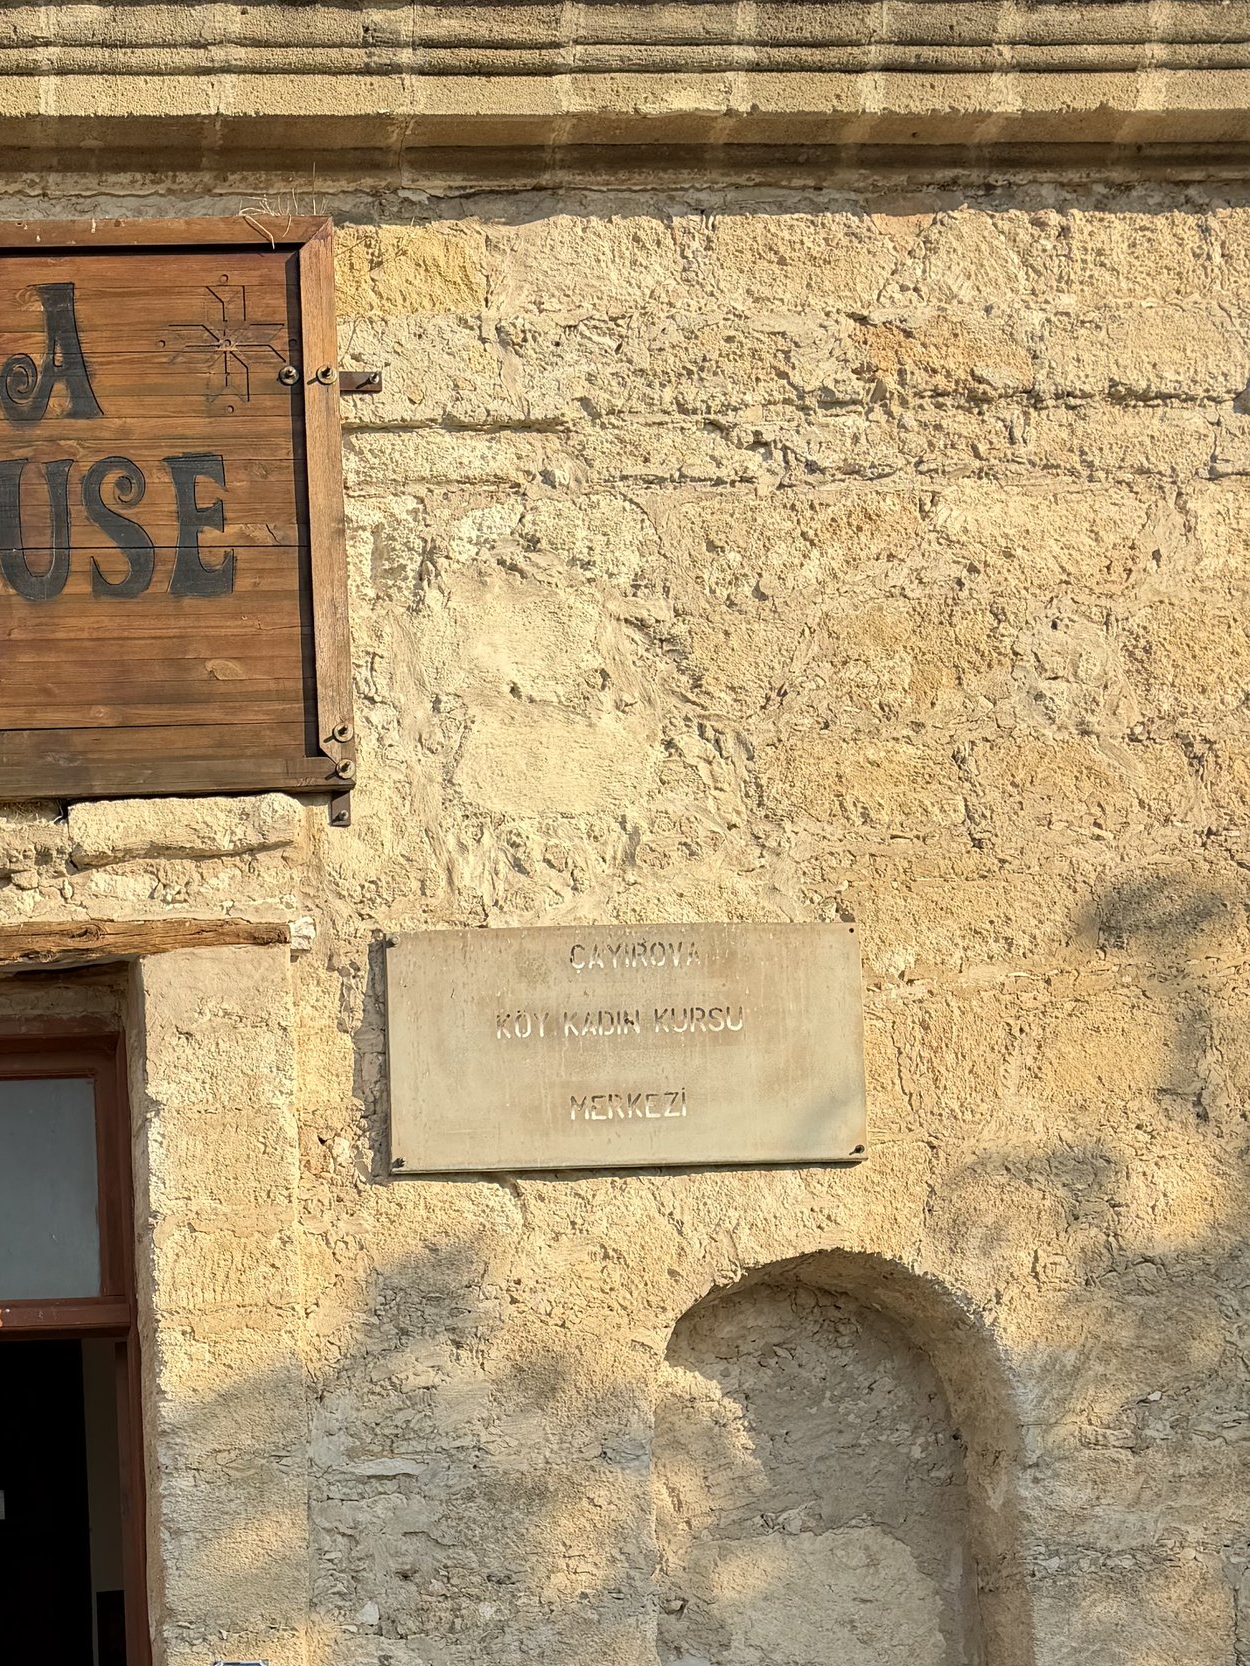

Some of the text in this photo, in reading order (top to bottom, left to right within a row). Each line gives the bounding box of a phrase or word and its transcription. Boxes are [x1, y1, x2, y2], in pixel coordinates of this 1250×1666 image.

[496, 1005, 744, 1040] KÖY KADIN KURSU
[570, 1087, 687, 1120] MERKEZİ
